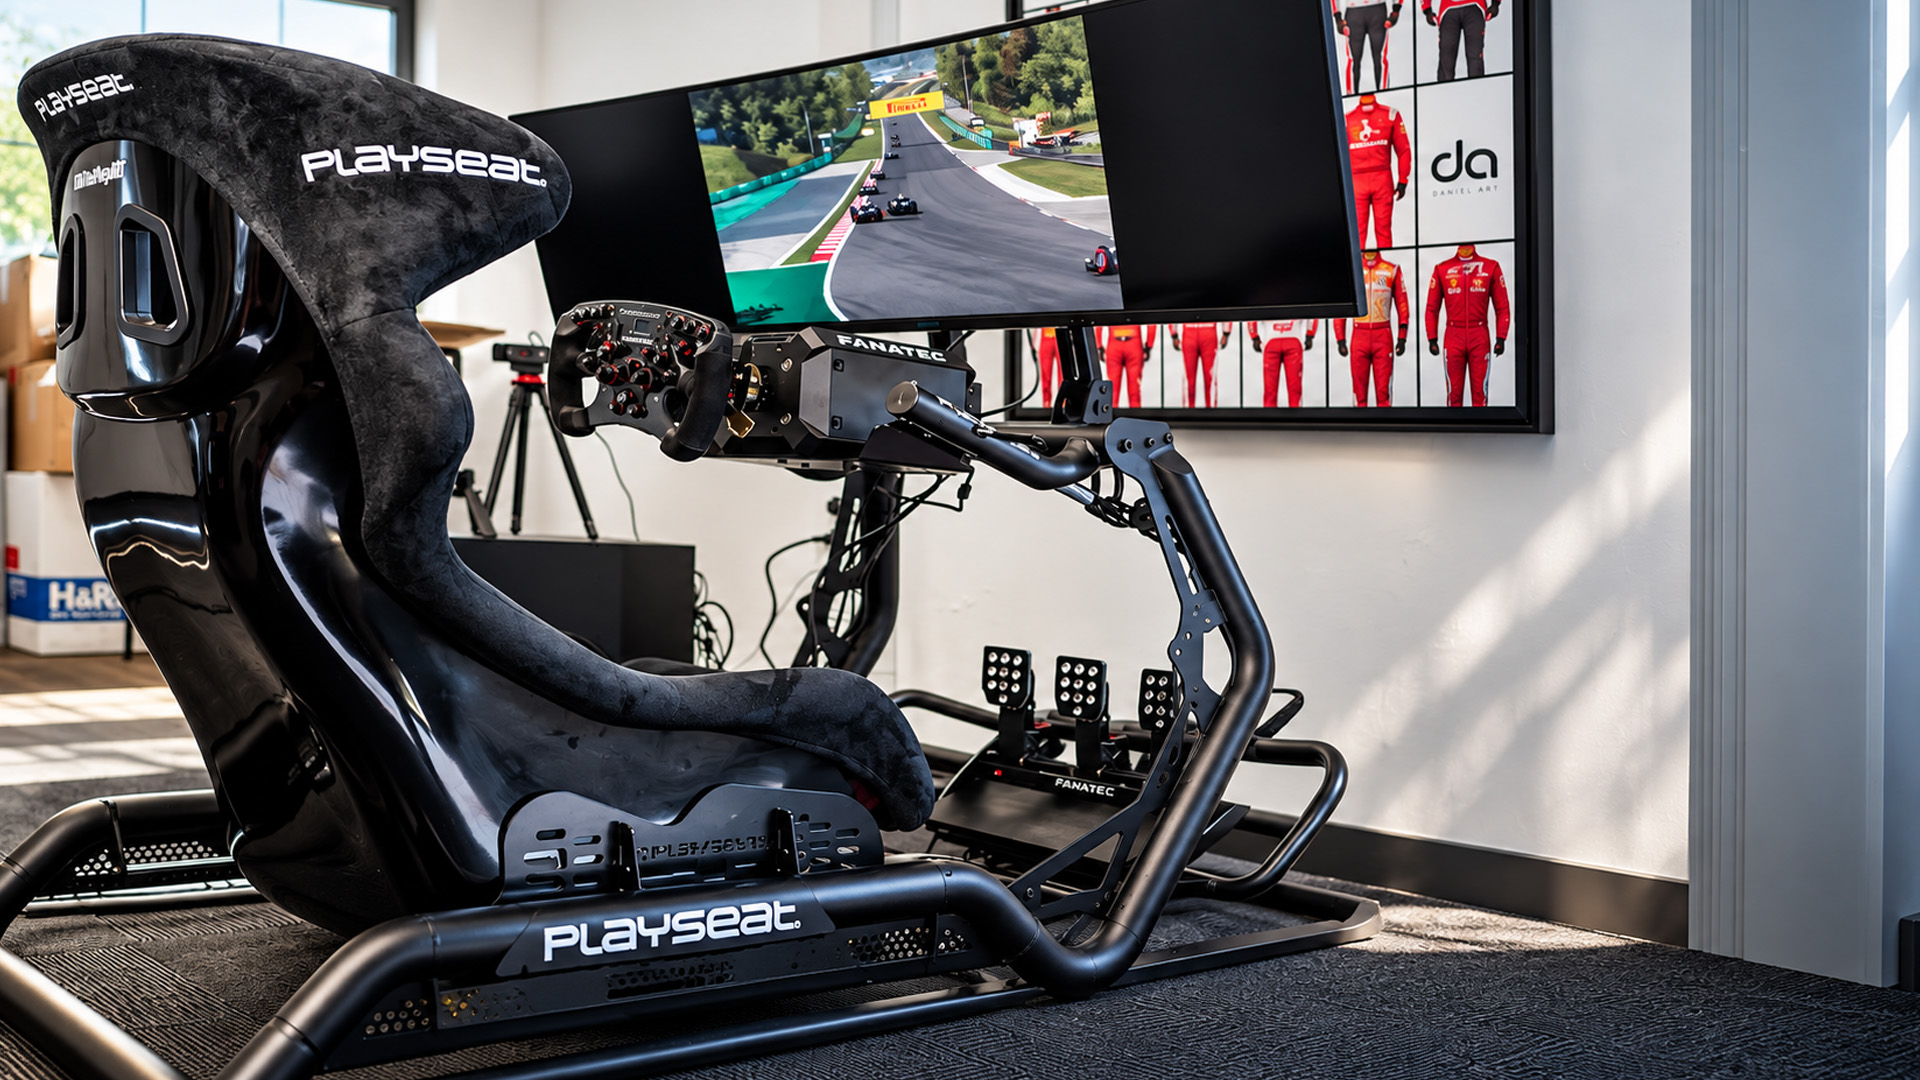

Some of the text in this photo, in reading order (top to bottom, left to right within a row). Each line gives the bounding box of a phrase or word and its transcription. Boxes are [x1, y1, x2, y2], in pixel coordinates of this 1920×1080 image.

[1431, 139, 1498, 183] da
[1433, 185, 1498, 197] DANIEL ART
[836, 335, 947, 362] FANATEC
[1055, 778, 1115, 797] FANATEC
